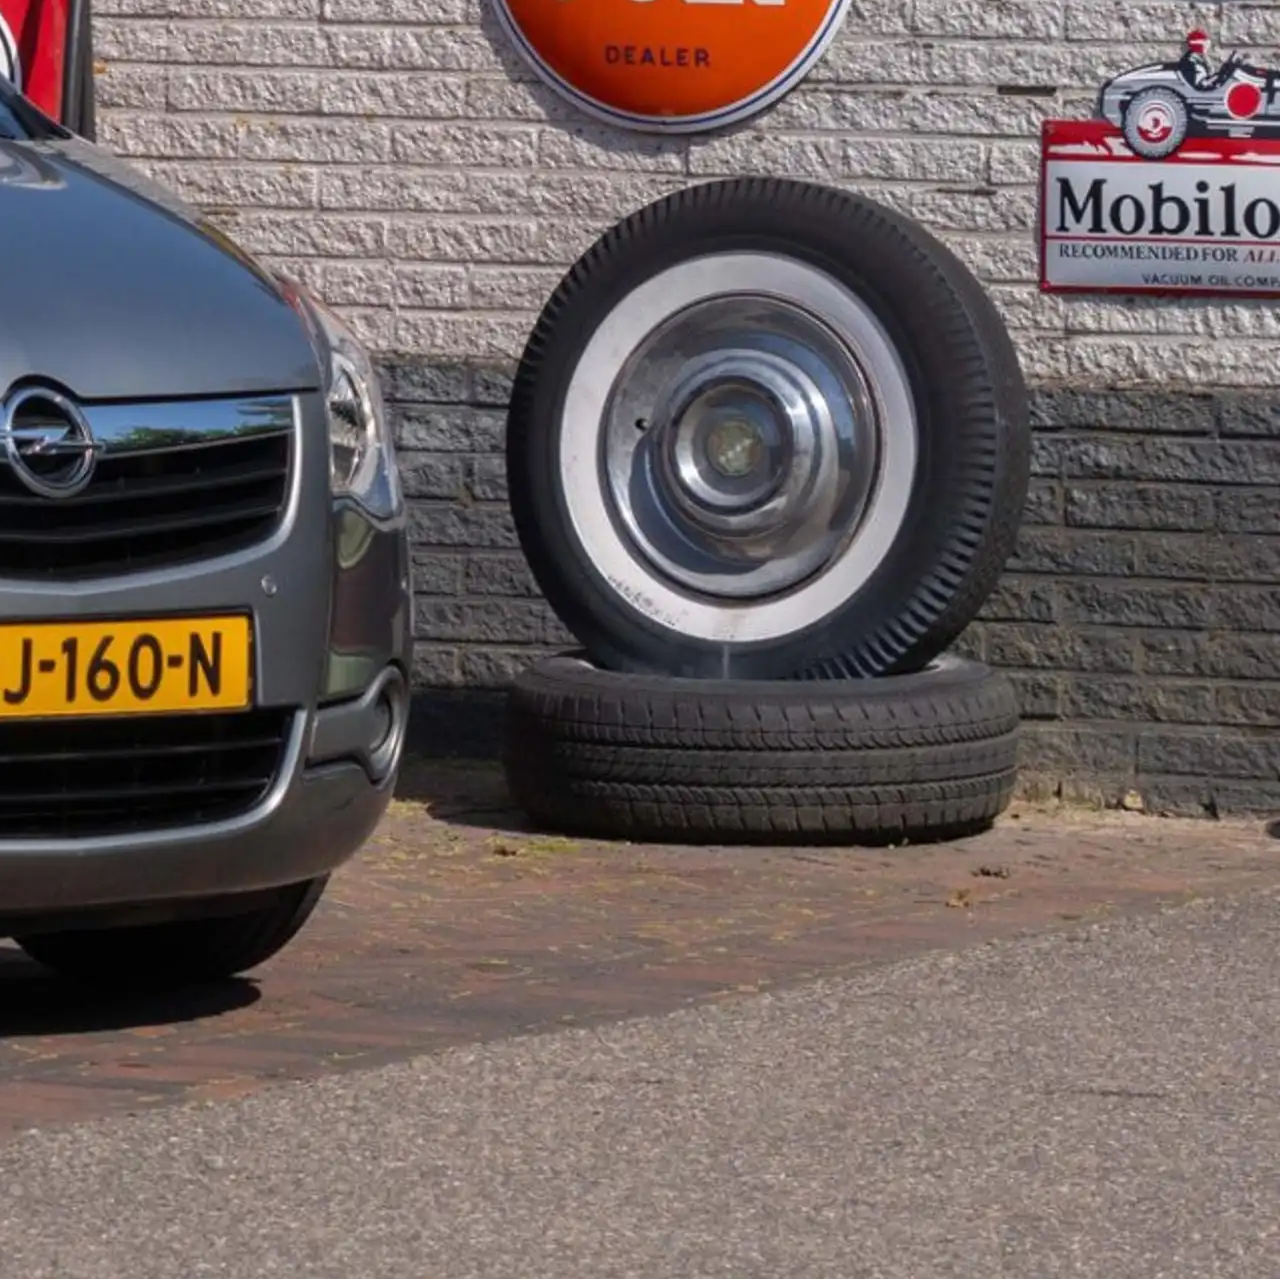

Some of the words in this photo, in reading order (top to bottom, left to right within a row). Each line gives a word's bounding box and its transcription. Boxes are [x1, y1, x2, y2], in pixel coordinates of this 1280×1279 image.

[605, 45, 711, 67] DEALER
[1056, 176, 1280, 239] Mobilo
[1059, 243, 1198, 262] RECOMMENDED
[1201, 246, 1238, 262] FOR
[1142, 274, 1202, 285] VACUUM
[1208, 275, 1231, 286] OIL
